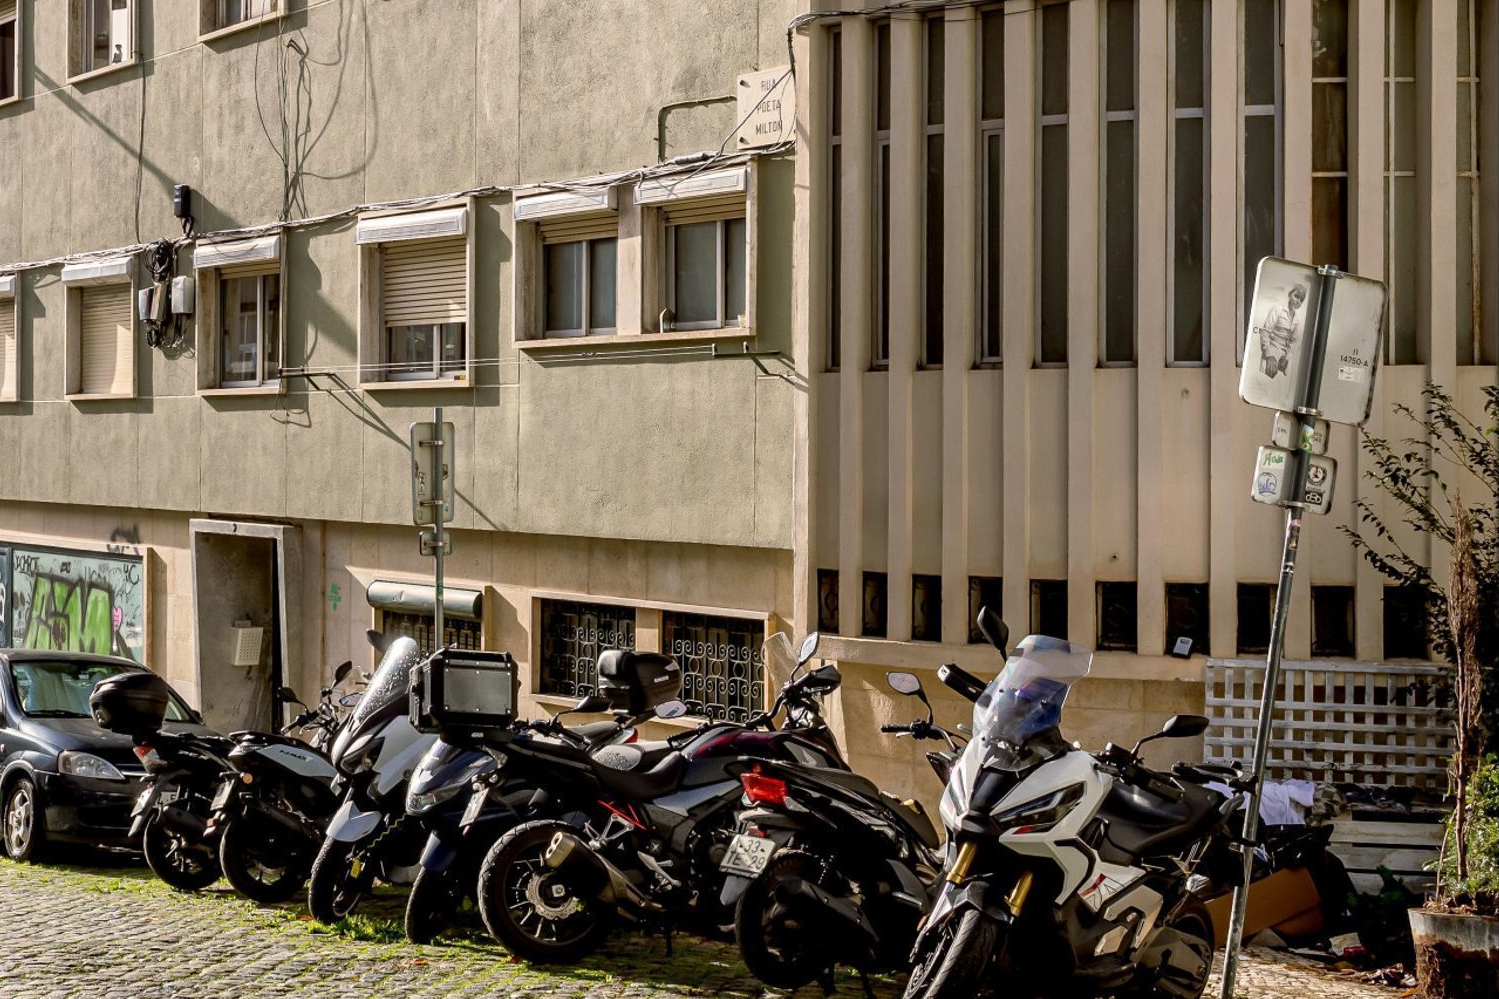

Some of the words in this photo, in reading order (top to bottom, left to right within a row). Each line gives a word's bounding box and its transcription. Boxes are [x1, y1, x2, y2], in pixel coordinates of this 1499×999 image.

[761, 79, 776, 92] RUA
[757, 100, 781, 114] POETA
[756, 120, 782, 135] MILTON
